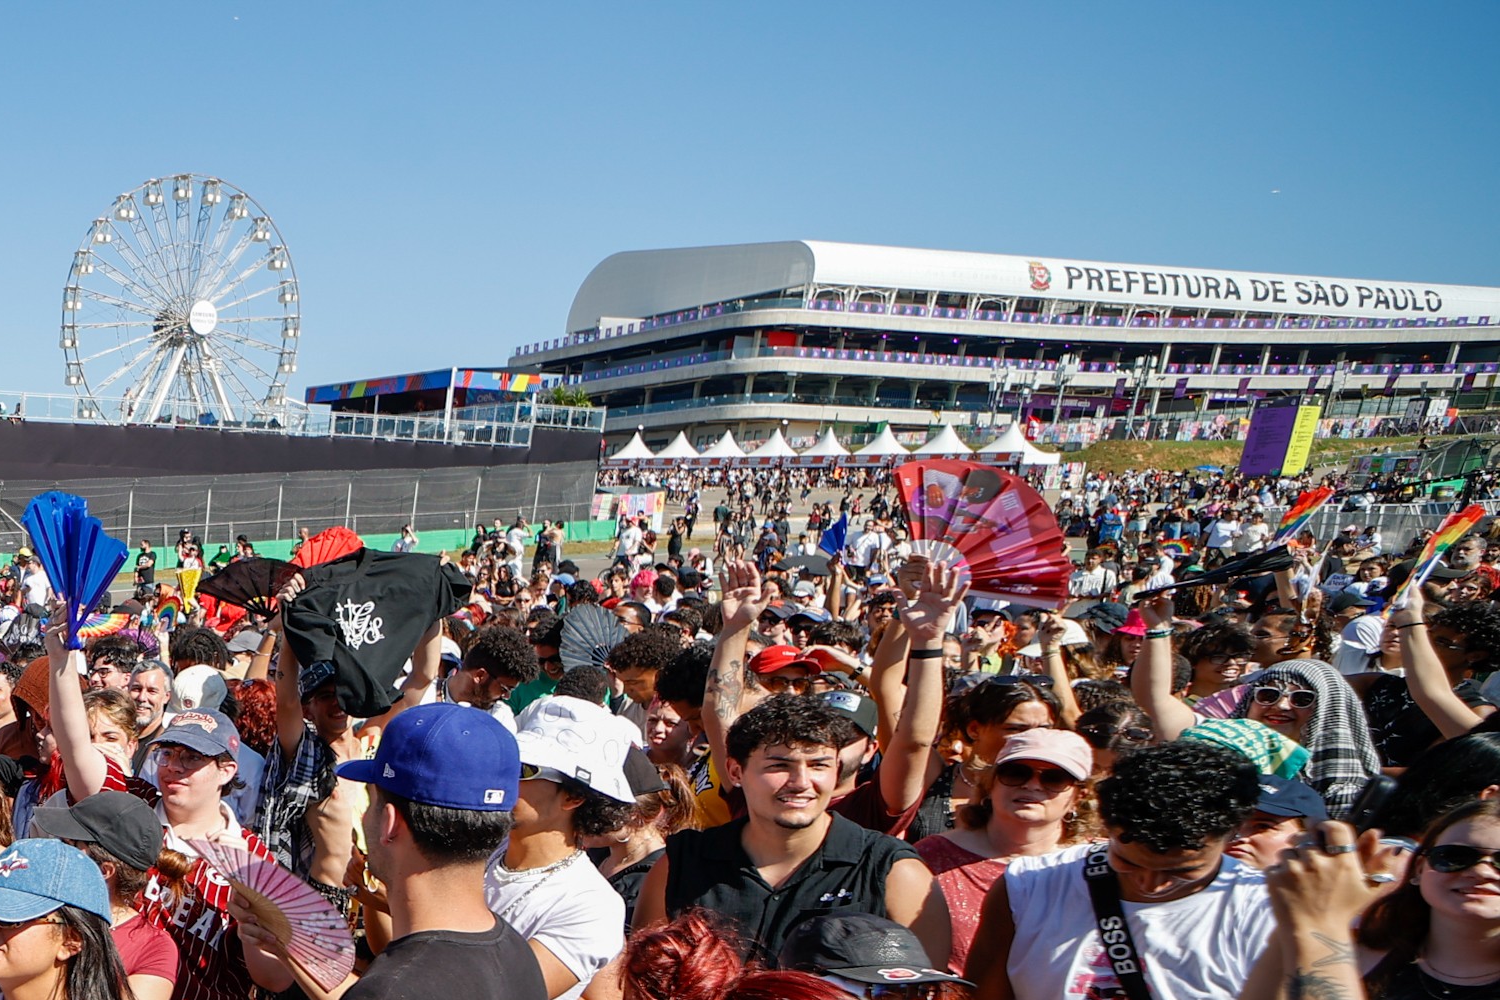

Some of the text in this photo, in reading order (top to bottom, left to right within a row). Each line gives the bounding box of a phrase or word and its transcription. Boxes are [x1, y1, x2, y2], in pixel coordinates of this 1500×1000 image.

[1064, 266, 1443, 313] PREFEITURA DE SÃO PAULO
[1086, 842, 1108, 877] BOS
[1100, 915, 1138, 975] BOSS
